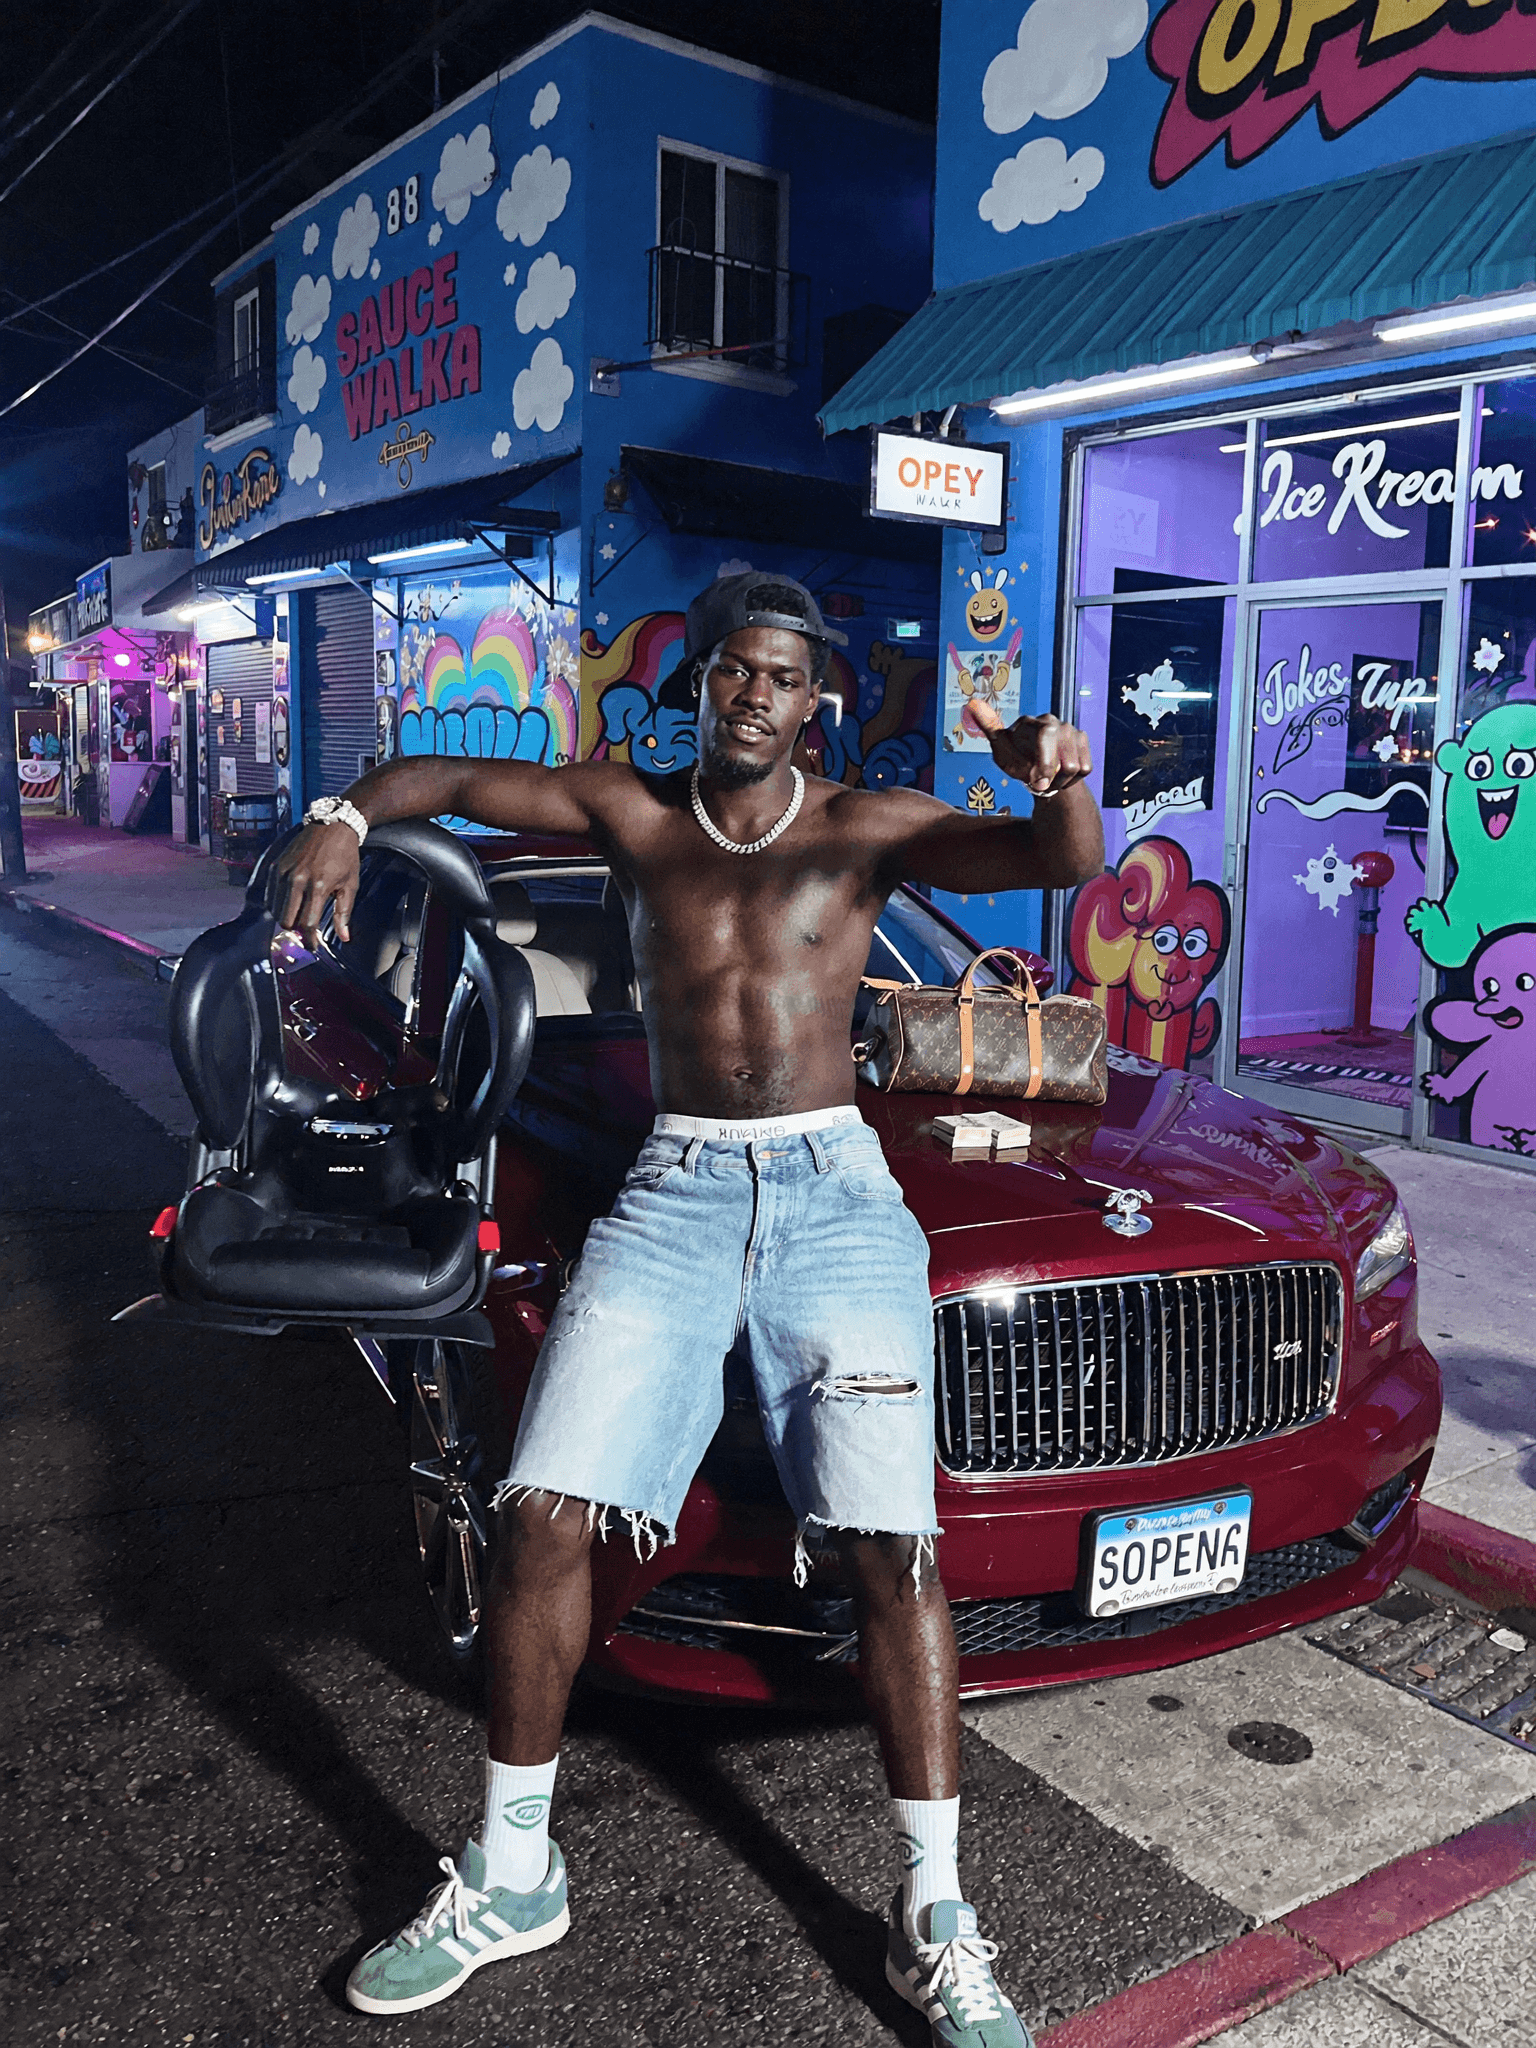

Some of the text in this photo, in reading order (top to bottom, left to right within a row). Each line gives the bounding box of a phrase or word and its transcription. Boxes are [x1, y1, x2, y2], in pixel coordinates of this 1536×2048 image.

[387, 175, 419, 235] 88
[336, 251, 458, 378] SAUCE
[341, 324, 480, 441] WALKA
[898, 457, 983, 496] OPEY
[1261, 643, 1348, 726] Jokes
